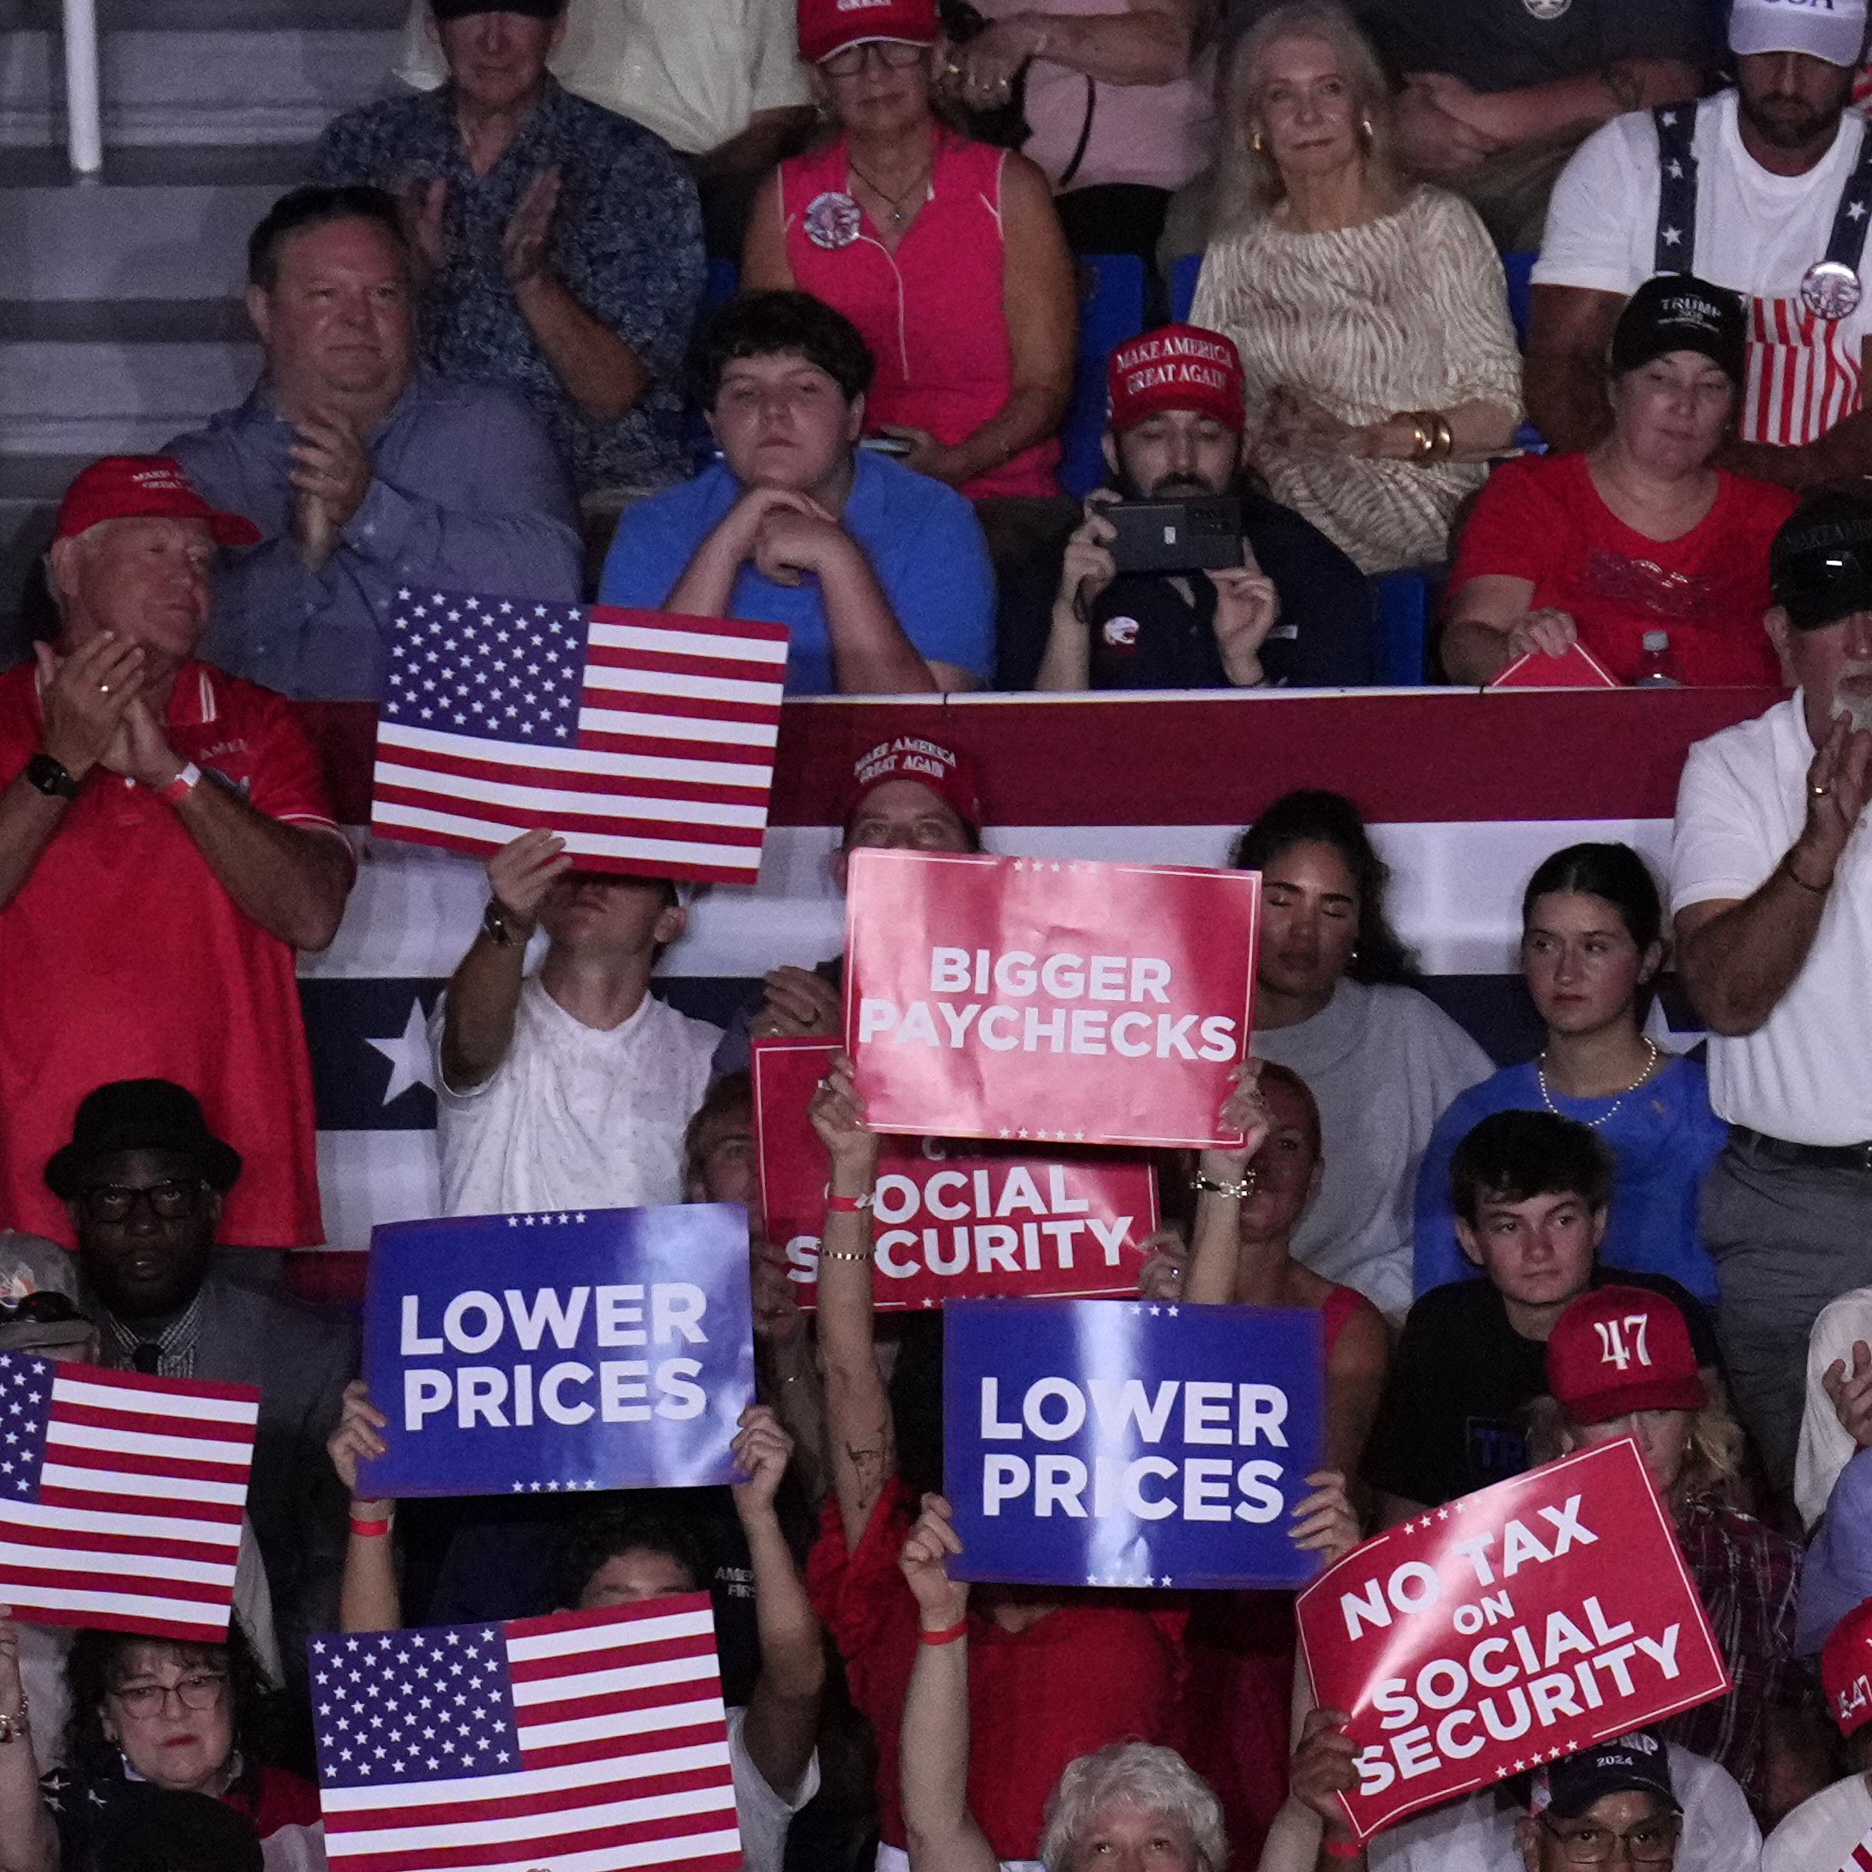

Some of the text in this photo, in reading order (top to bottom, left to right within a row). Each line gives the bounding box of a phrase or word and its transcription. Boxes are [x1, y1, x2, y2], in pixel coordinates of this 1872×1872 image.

[1116, 336, 1235, 374] MAKE AMERICA
[1128, 361, 1228, 396] GREAT AGAIN
[891, 736, 957, 768] AMERICA
[930, 945, 1173, 1005] BIGGER
[859, 1000, 1238, 1064] PAYCHECKS
[400, 1282, 707, 1356] LOWER
[1594, 1314, 1652, 1369] 47
[404, 1357, 706, 1432] PRICES
[980, 1375, 1289, 1447] LOWER
[982, 1453, 1284, 1525] PRICES
[1338, 1494, 1599, 1642] NO TAX
[1453, 1589, 1514, 1635] ON
[1371, 1596, 1634, 1730] SOCIAL
[1356, 1623, 1681, 1796] SECURITY
[1595, 1754, 1635, 1768] 2024
